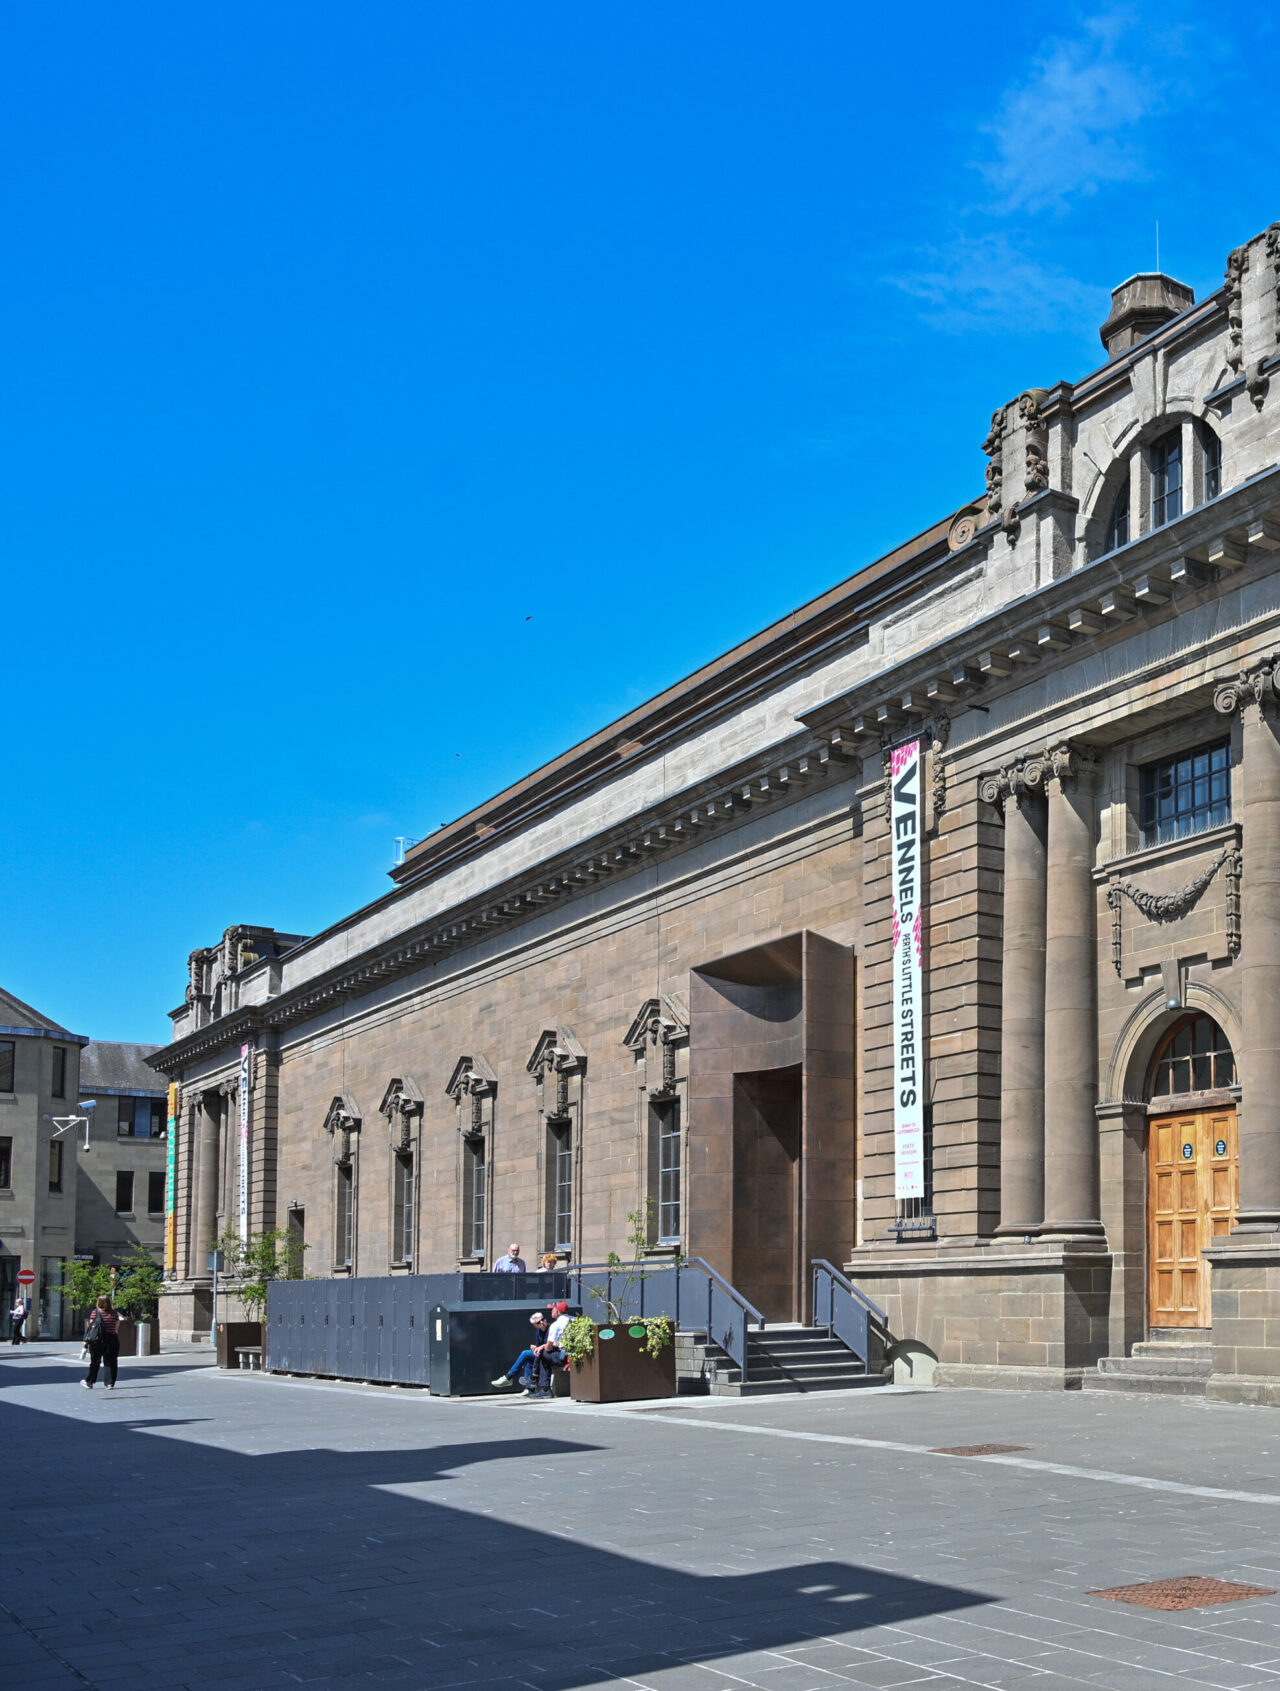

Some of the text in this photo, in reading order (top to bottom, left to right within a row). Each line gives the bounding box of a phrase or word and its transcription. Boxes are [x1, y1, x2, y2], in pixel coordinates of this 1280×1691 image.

[893, 761, 918, 924] VENNELS
[902, 933, 911, 966] PERTH'S
[901, 966, 913, 1006] LITTLE
[900, 1009, 917, 1108] STREETS
